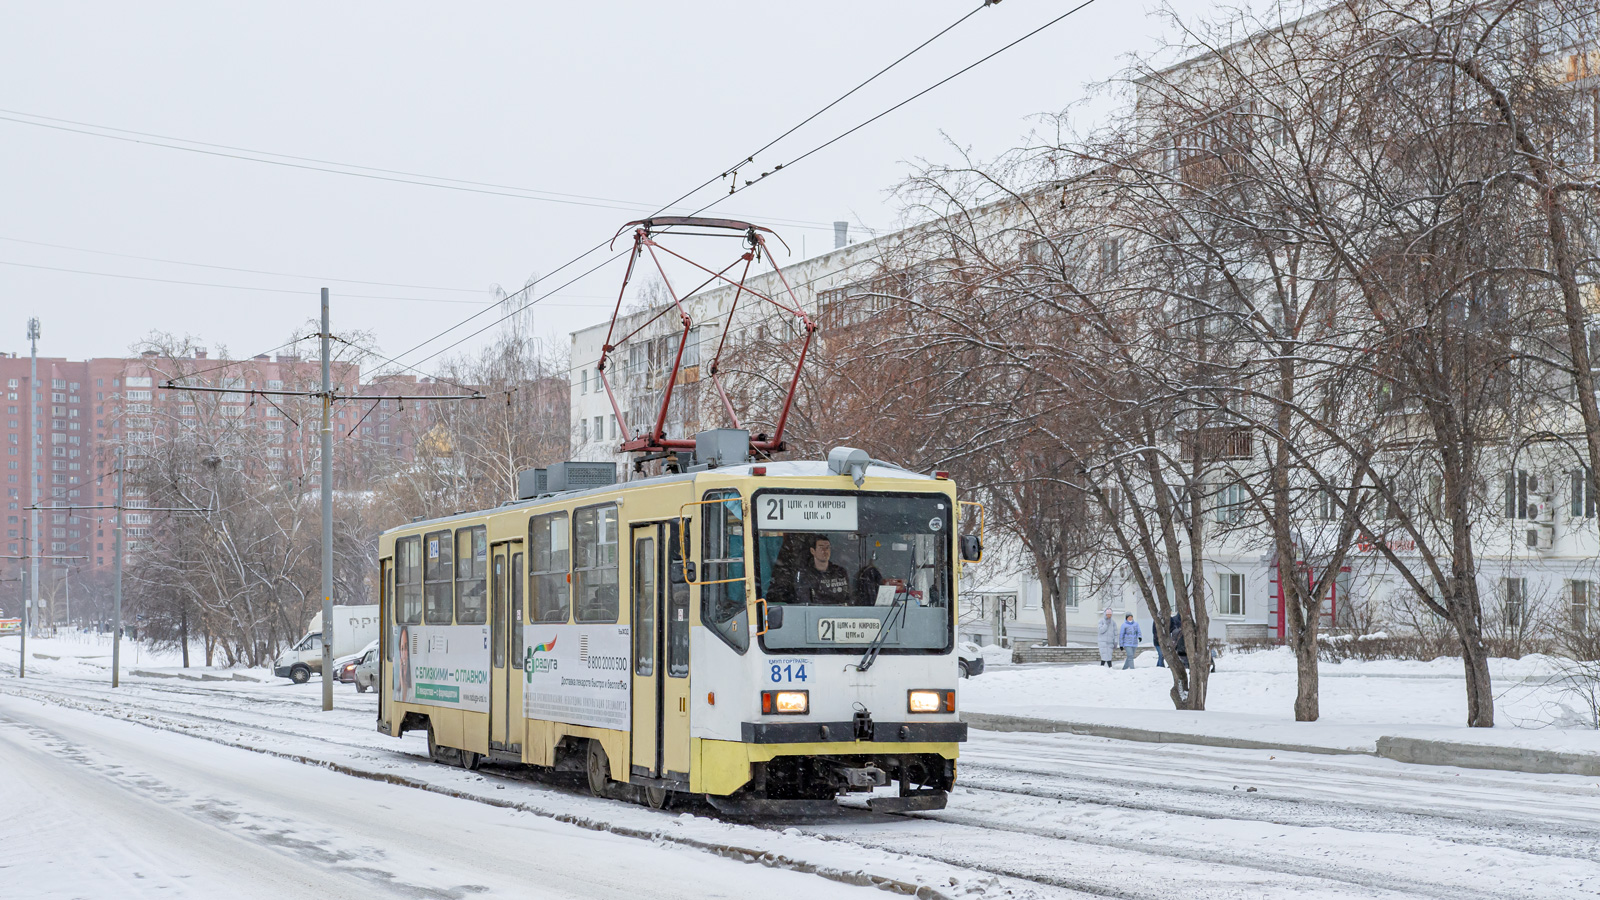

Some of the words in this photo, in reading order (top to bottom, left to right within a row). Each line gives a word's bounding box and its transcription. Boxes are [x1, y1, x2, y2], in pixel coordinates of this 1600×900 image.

[766, 498, 784, 520] 21
[787, 500, 803, 509] ЦПК
[803, 511, 819, 520] ЦПК
[820, 620, 835, 641] 21
[587, 655, 591, 669] 8
[591, 655, 602, 670] 800
[602, 656, 615, 671] 2000
[615, 656, 628, 671] 500
[771, 664, 808, 682] 814
